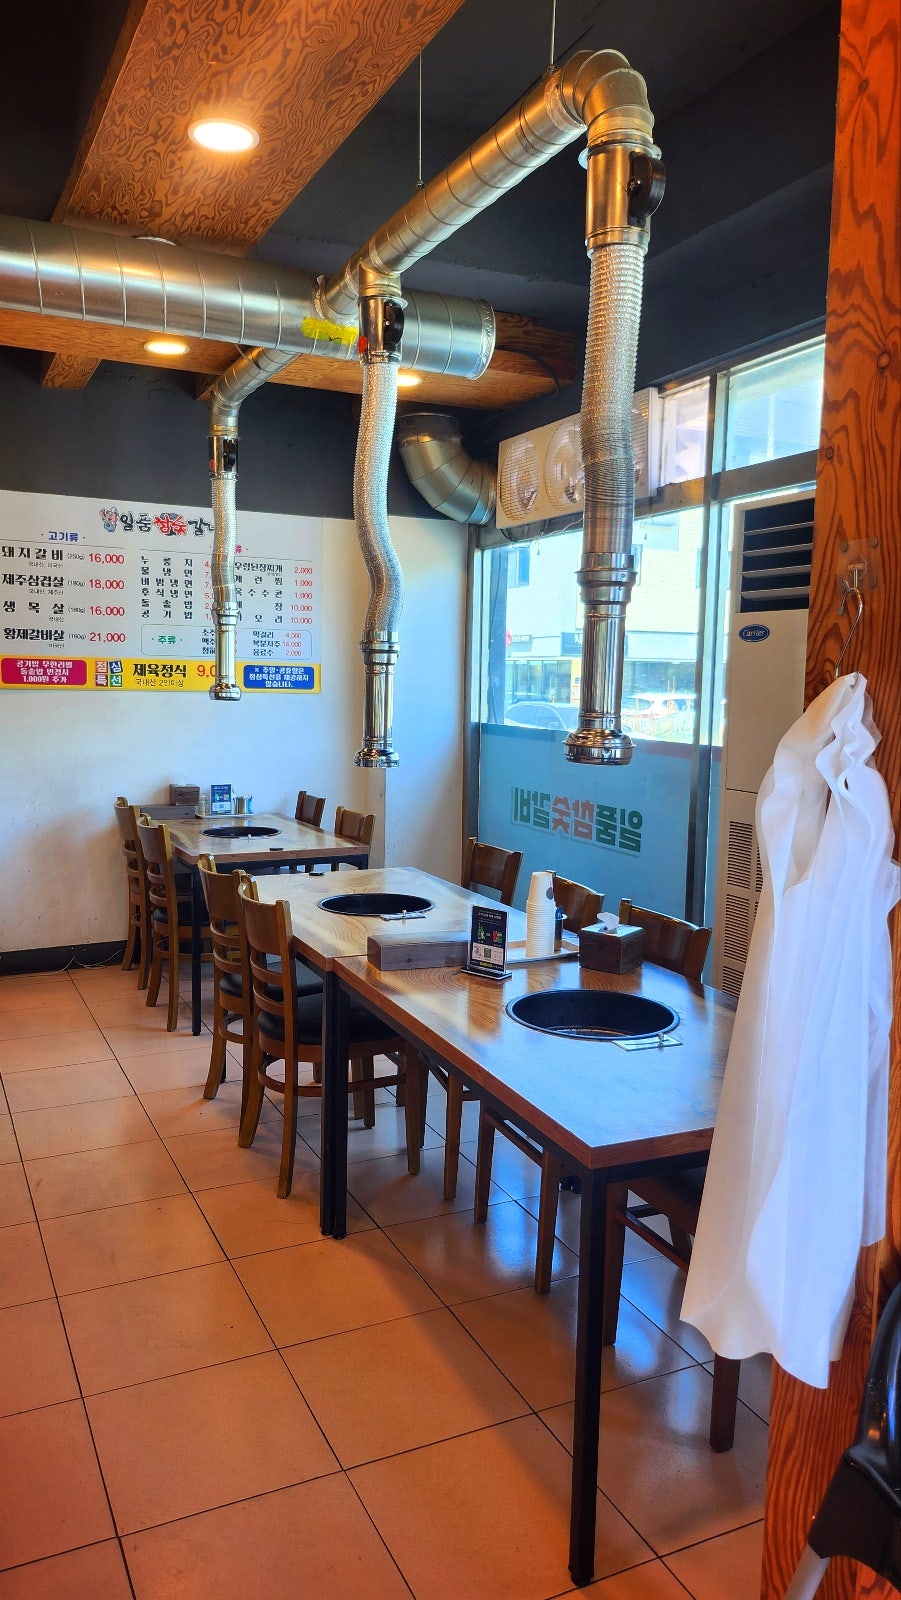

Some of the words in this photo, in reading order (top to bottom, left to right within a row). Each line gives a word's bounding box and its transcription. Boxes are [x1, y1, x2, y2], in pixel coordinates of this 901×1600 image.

[48, 531, 79, 542] 고기류
[89, 552, 125, 564] 16,000
[2, 573, 64, 588] 제주삼겹살
[89, 578, 125, 590] 18,000
[89, 605, 125, 617] 16,000
[3, 627, 65, 642] 황제갈비살
[89, 631, 126, 643] 21,000
[743, 629, 765, 637] Carrier
[158, 635, 177, 645] 주류
[132, 663, 187, 678] 제육정식
[135, 678, 157, 687] 국내산
